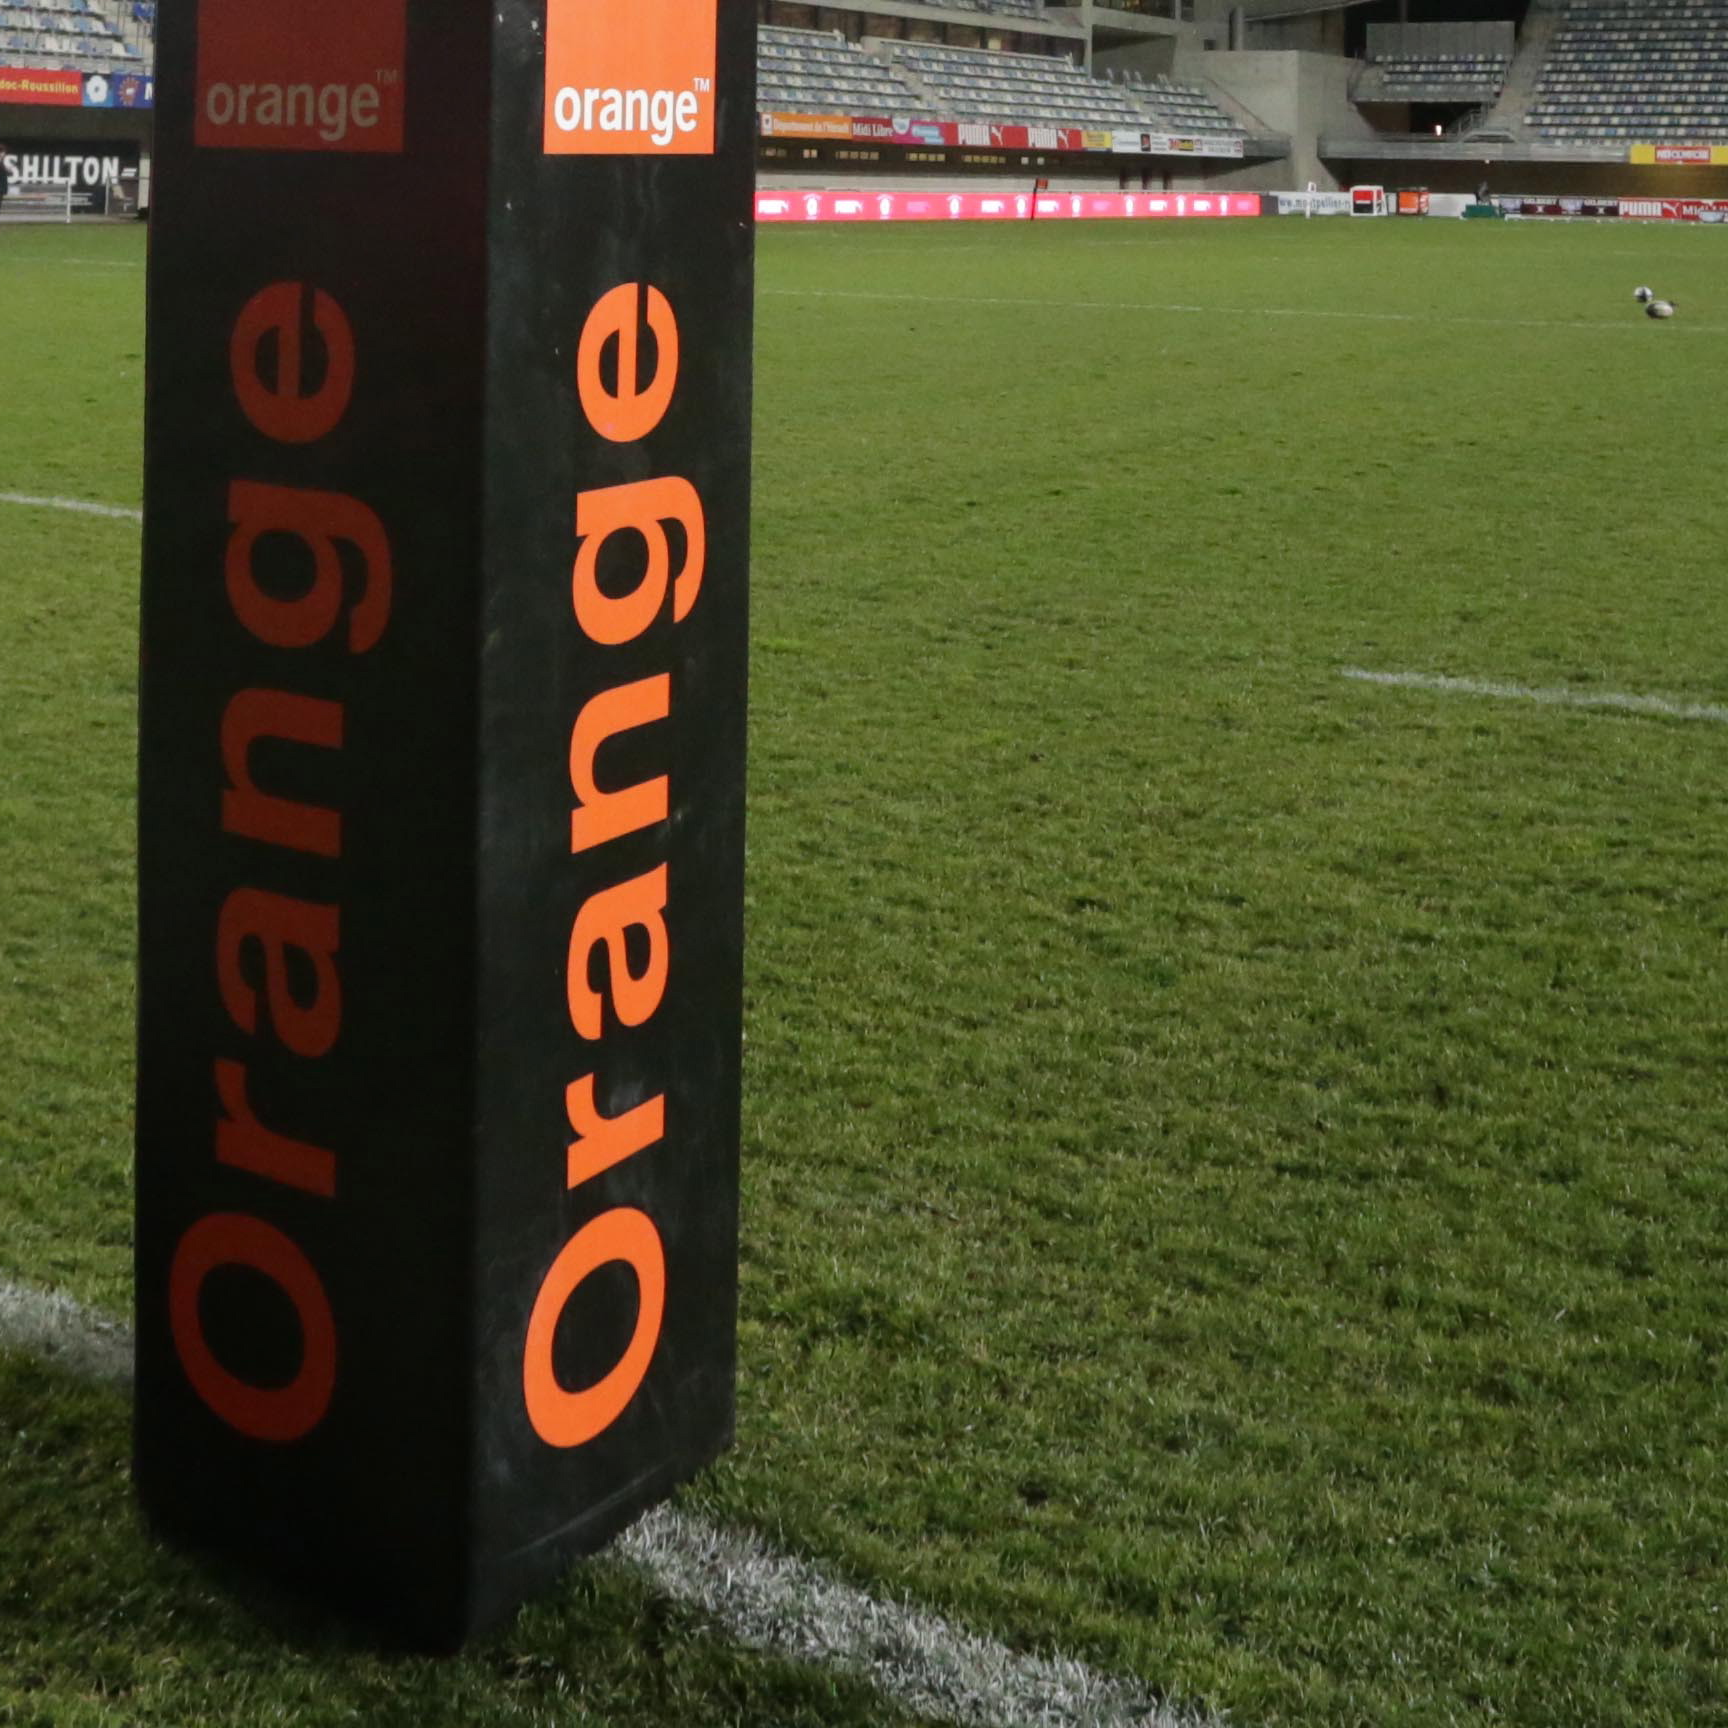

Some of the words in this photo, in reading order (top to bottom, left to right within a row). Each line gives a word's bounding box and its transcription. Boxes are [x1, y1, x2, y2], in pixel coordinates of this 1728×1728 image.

[206, 82, 380, 142] orange
[553, 86, 699, 146] orange
[3, 153, 119, 185] SHILTON
[1618, 200, 1663, 217] PUMA
[169, 280, 393, 1443] Orange
[523, 282, 706, 1447] Orange
